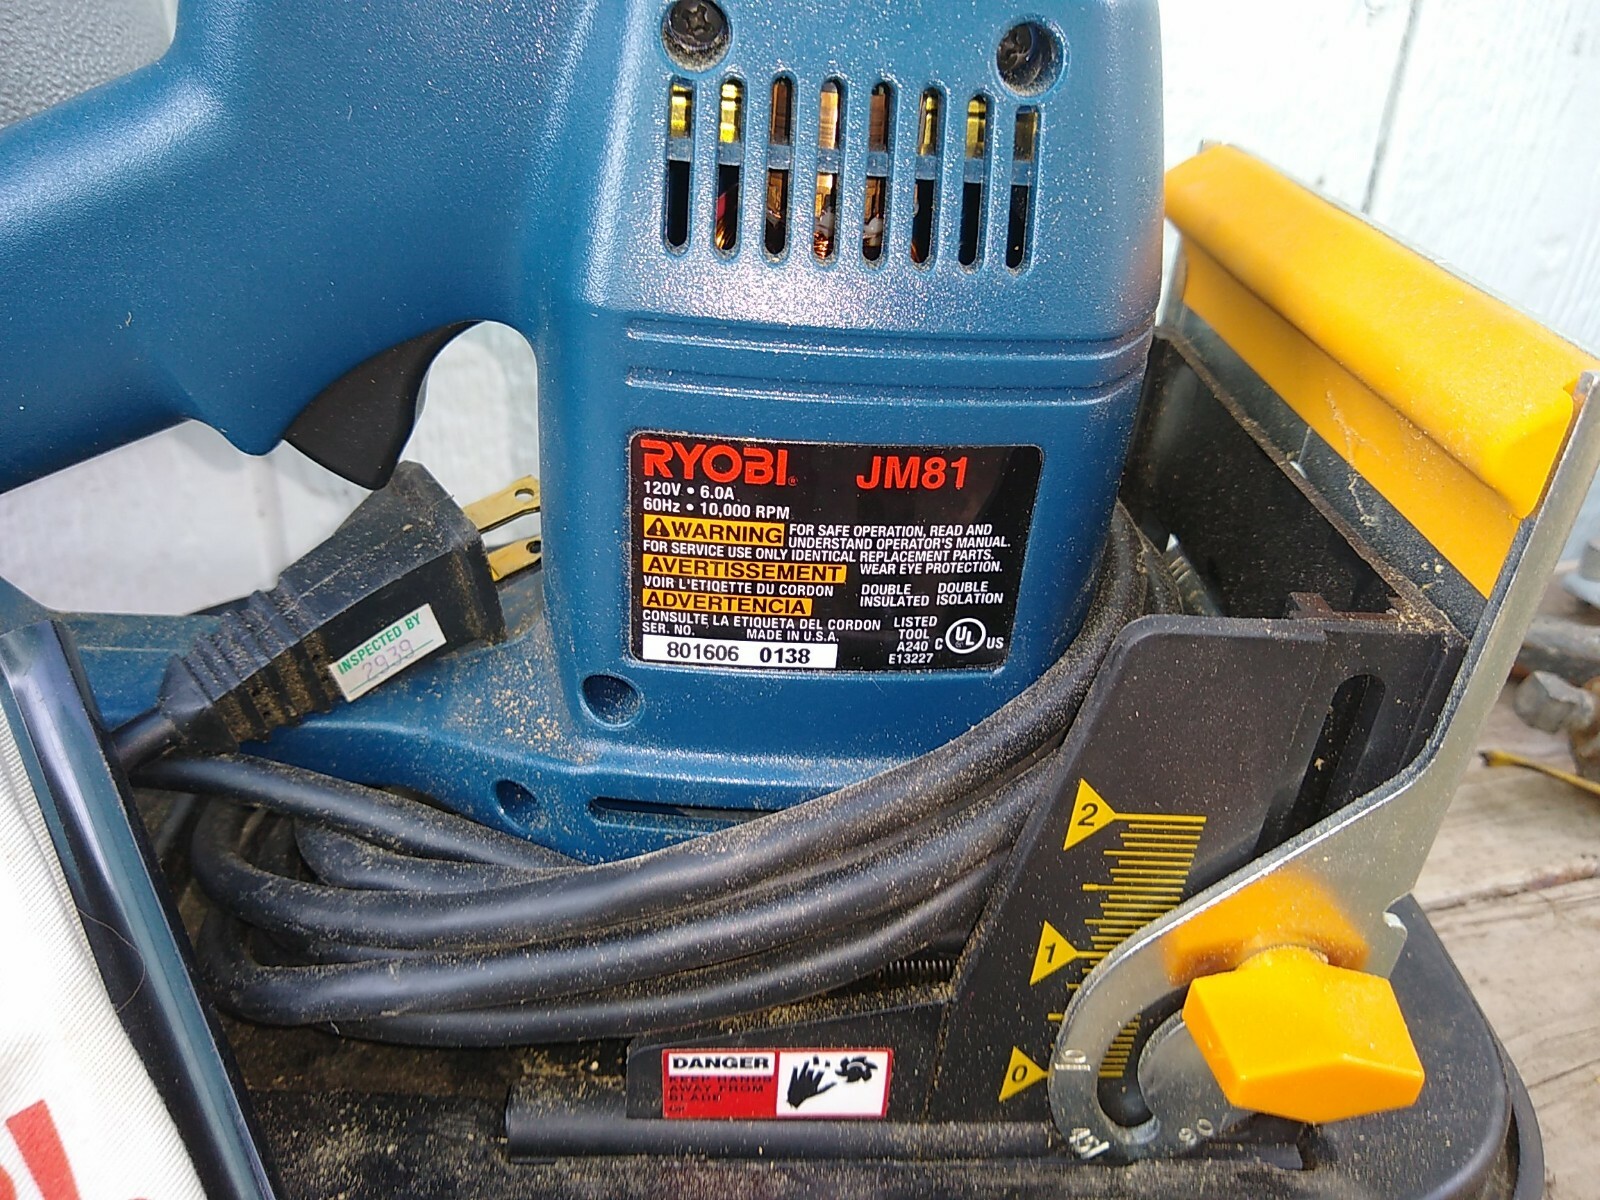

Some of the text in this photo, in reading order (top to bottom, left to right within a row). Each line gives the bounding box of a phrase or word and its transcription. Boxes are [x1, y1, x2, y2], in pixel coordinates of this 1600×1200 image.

[640, 438, 788, 486] RYOBI
[856, 455, 969, 490] JM81
[643, 480, 734, 500] 120V 6.0A
[643, 497, 790, 520] 60Hz 10,000 RPM
[671, 521, 782, 544] WARNING
[789, 523, 993, 538] FOR SAFE OPERATION, READ AND
[789, 536, 1011, 550] UNDERSTAND OPERATOR'S MANUAL.
[643, 539, 994, 563] FOR SERVICE USE ONLY IDENTICAL REPLACEMENT PARTS.
[648, 556, 843, 582] AVERTISSEMENT
[860, 561, 1003, 575] WEAR EYE PROTECTION.
[643, 575, 674, 589] VOIR
[756, 583, 775, 595] DU
[778, 583, 834, 597] CORDON
[861, 584, 912, 595] DOUBLE
[937, 581, 989, 593] DOUBLE
[646, 591, 807, 614] ADVERTENCIA
[859, 595, 930, 607] INSULATED
[936, 592, 1004, 606] ISOLATION
[642, 610, 881, 631] CONSULTE LA ETIQUETA DEL CORDON
[894, 616, 938, 628] LISTED
[642, 621, 696, 636] SER. NO.
[746, 628, 839, 642] MADE IN U.S.A.
[898, 628, 930, 640] TOOL
[337, 612, 421, 675] INSPECTED BY
[896, 640, 928, 652] A240
[934, 637, 943, 650] C
[986, 637, 1004, 650] US
[666, 641, 811, 664] 801606 0138
[889, 652, 934, 665] E13227
[1077, 802, 1099, 827] 2
[1045, 943, 1057, 964] 1
[672, 1055, 770, 1069] DANGER
[1011, 1063, 1028, 1082] 0
[669, 1084, 712, 1093] AWAY
